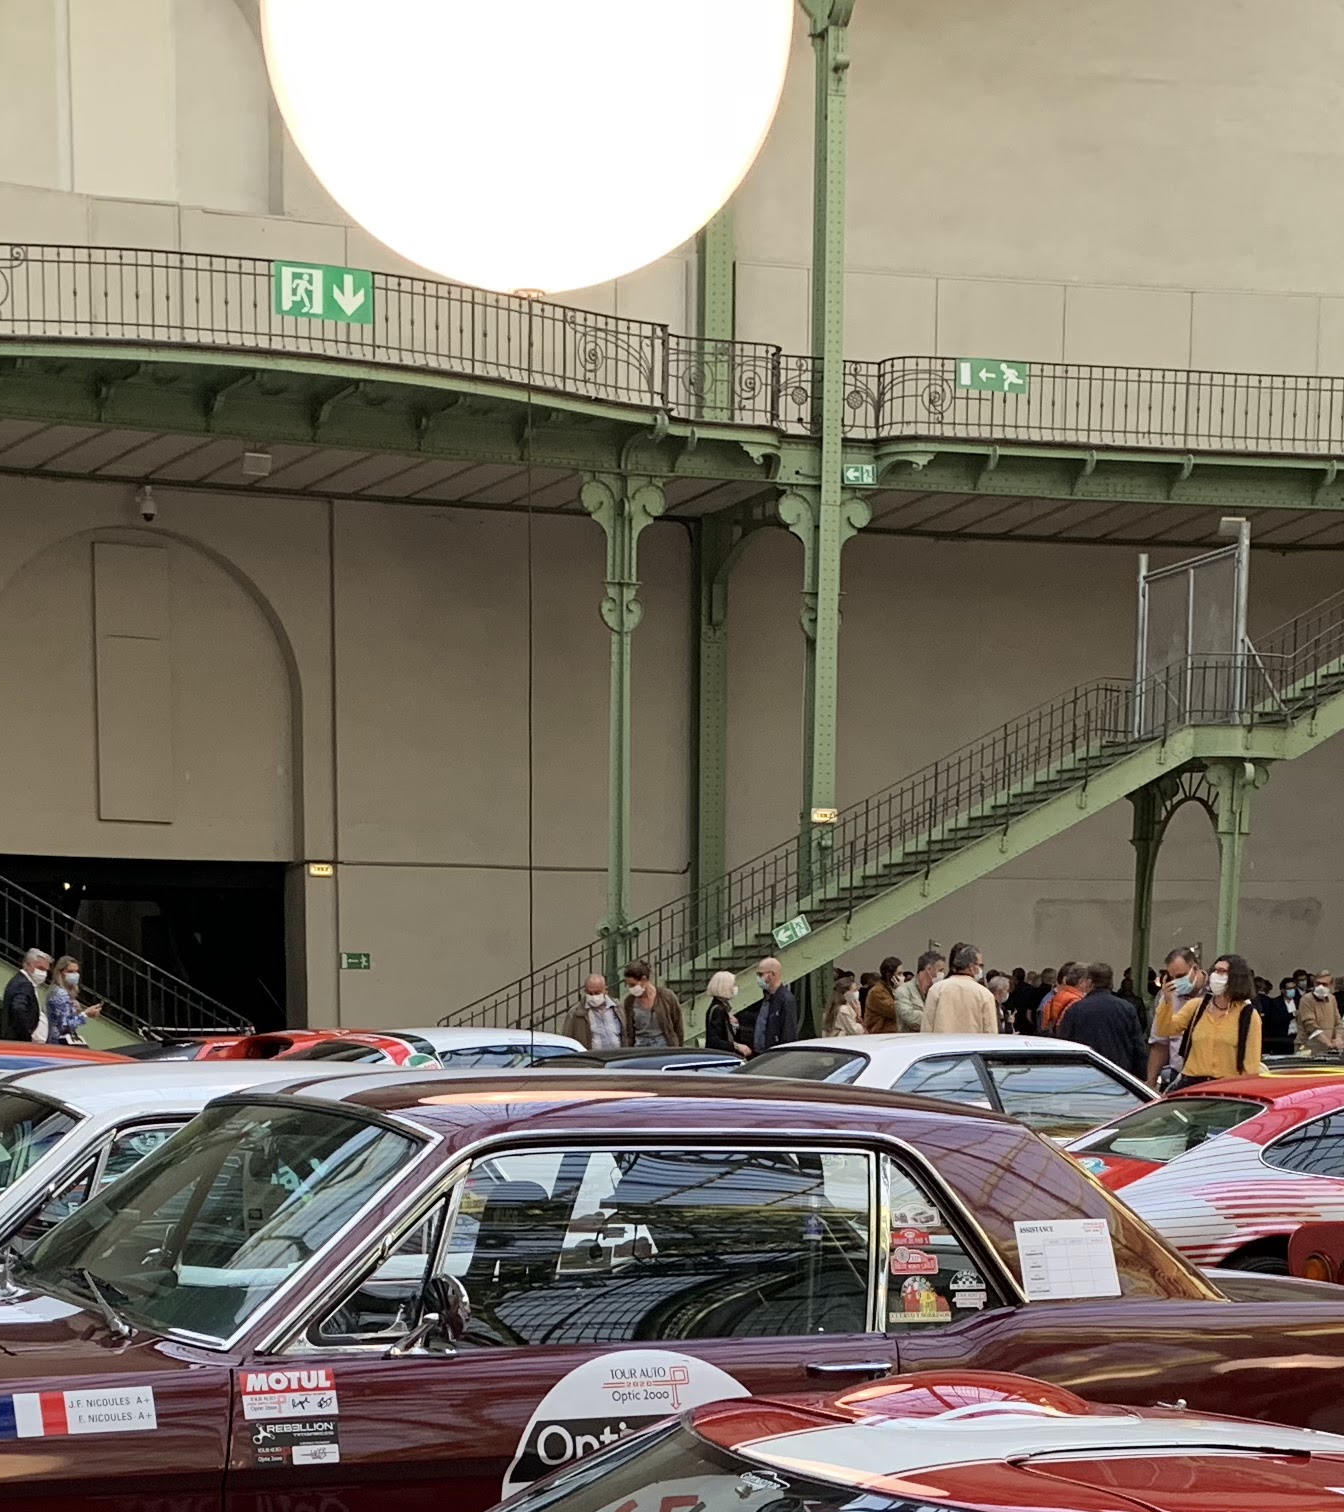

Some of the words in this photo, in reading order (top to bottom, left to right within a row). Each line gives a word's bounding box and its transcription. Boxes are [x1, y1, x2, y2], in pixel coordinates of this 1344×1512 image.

[610, 1369, 638, 1380] TOUR
[639, 1367, 666, 1379] AUTO
[246, 1370, 331, 1392] MOTUL
[86, 1397, 131, 1408] NICOULES
[611, 1390, 642, 1404] Optic
[643, 1389, 670, 1401] 2000
[88, 1412, 133, 1423] NICOULES
[138, 1412, 153, 1420] A+
[266, 1421, 334, 1433] REBELLION
